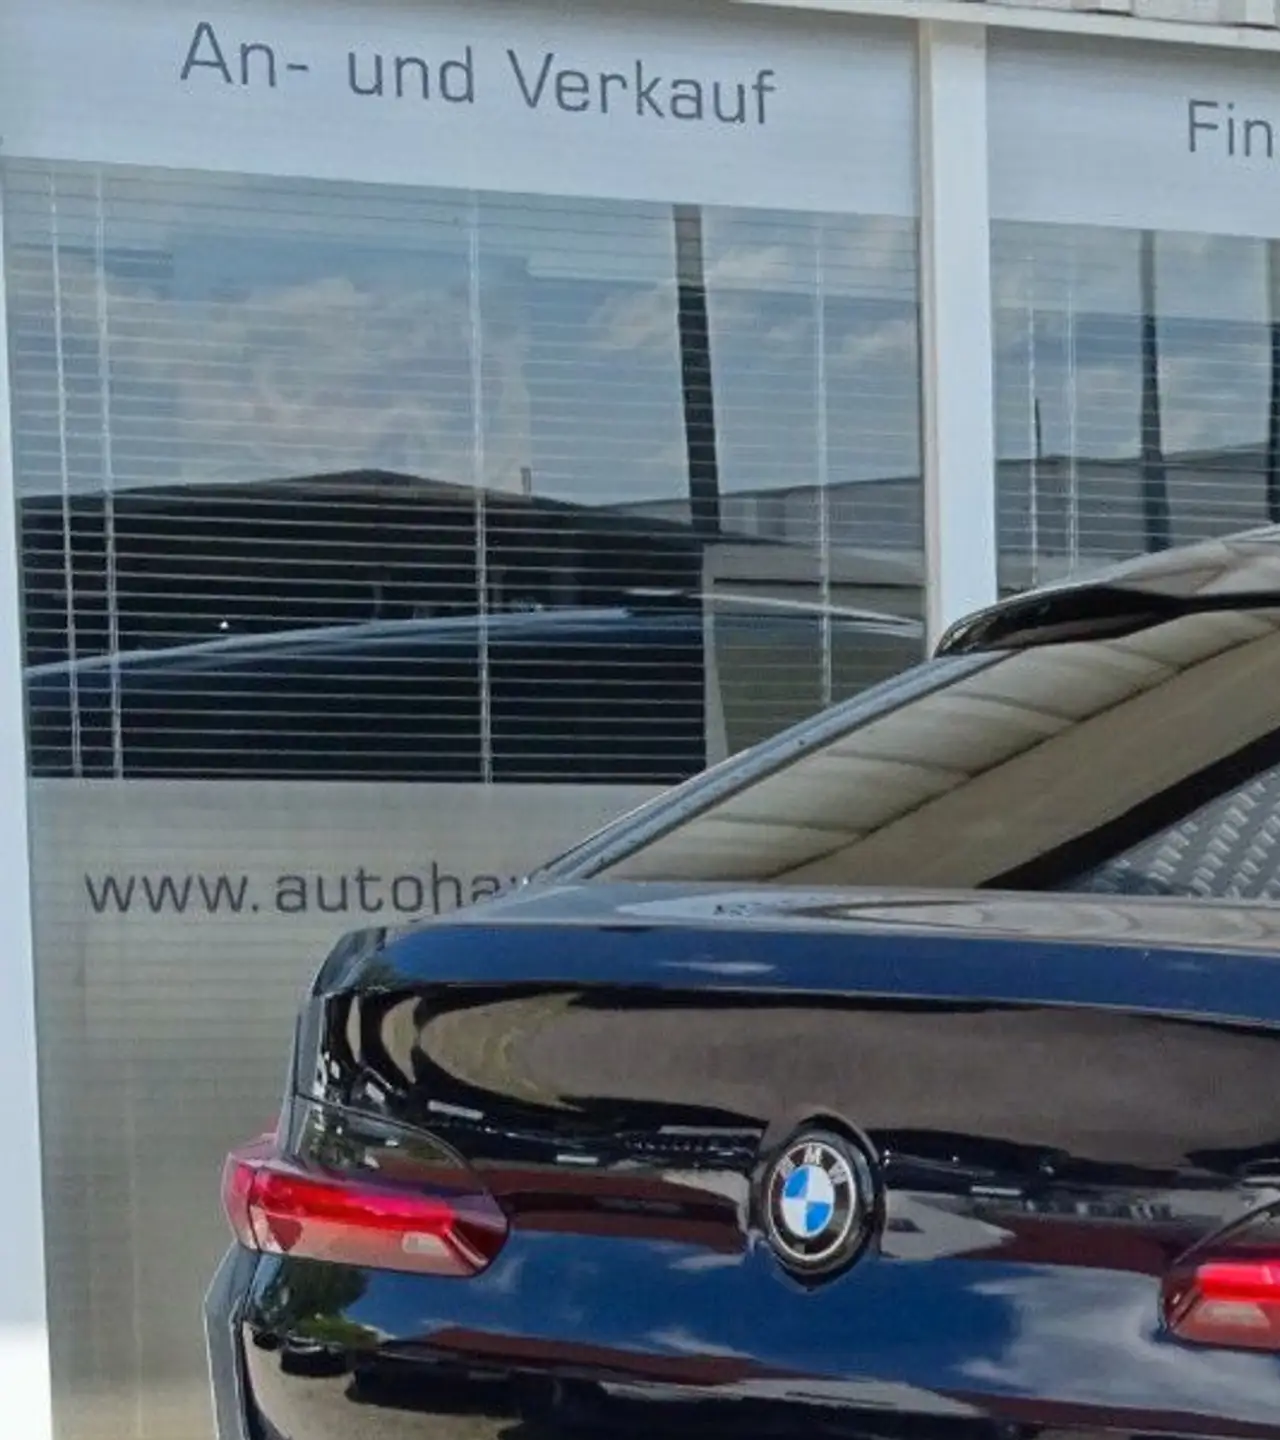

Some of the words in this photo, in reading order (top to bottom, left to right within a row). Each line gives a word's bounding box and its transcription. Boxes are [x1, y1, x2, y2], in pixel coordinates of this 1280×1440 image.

[180, 22, 310, 88] An-
[347, 46, 476, 104] und
[507, 49, 777, 126] Verkauf
[84, 860, 518, 914] www.autoha
[778, 1142, 850, 1185] BMW
